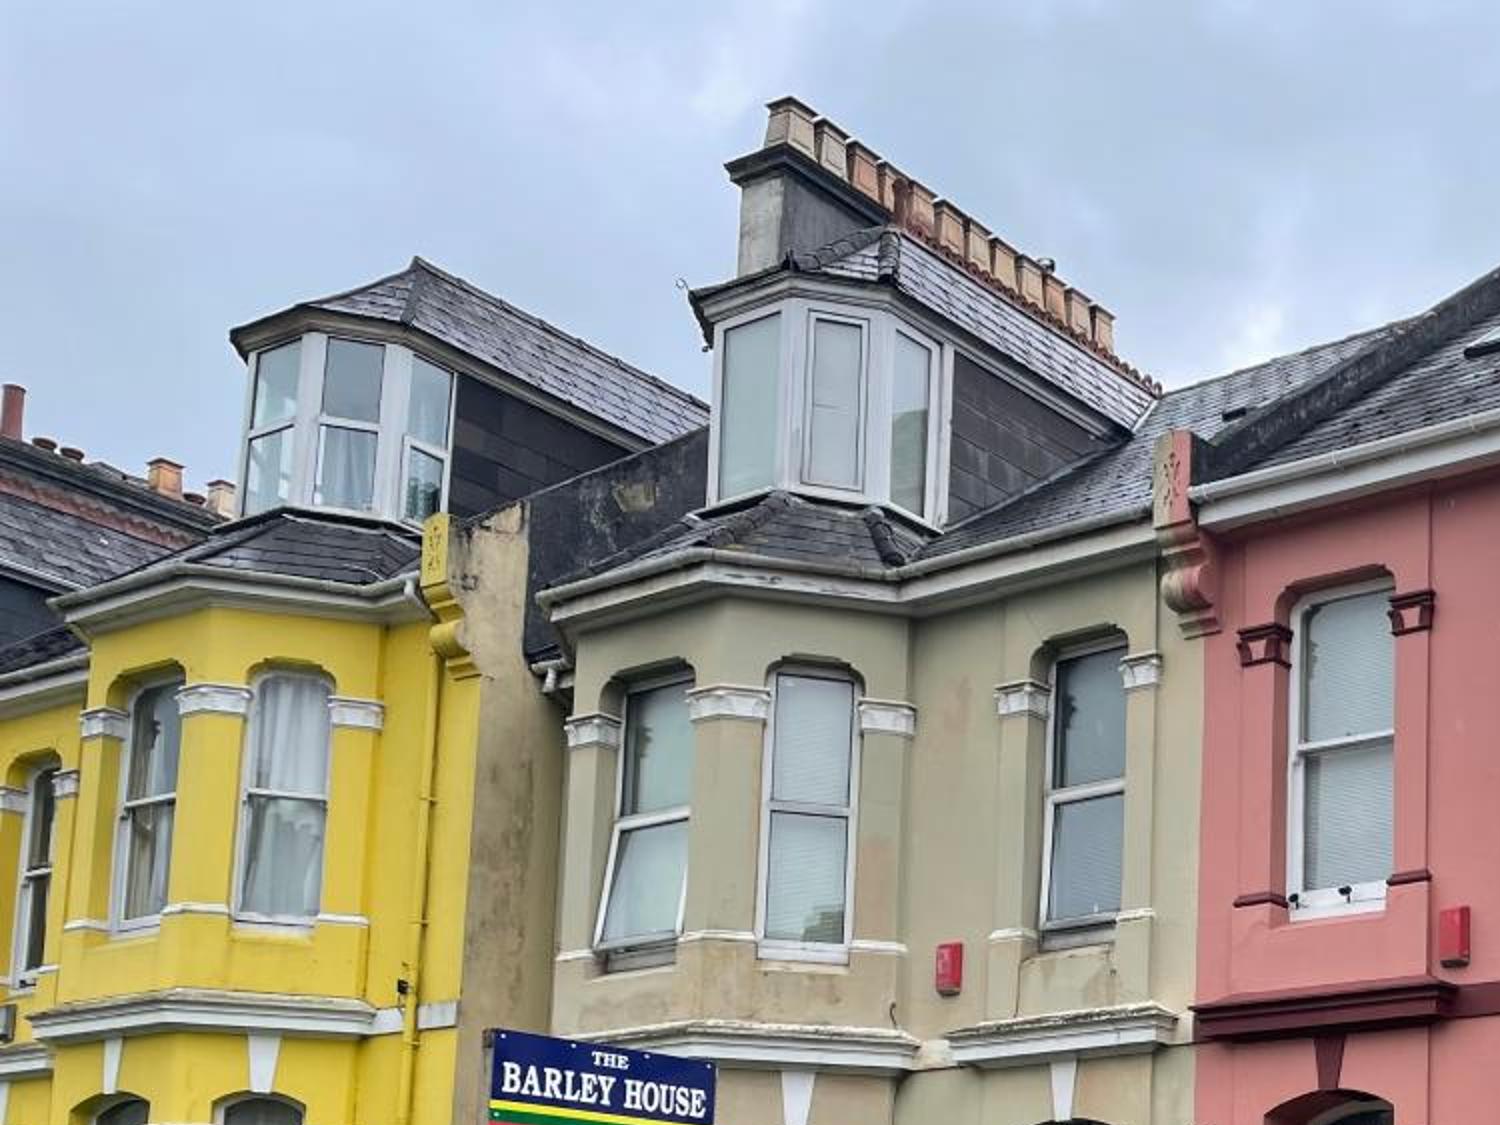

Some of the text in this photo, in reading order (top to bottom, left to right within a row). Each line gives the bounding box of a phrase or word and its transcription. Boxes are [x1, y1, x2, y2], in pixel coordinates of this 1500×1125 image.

[592, 1051, 630, 1070] THE
[502, 1062, 706, 1118] BARLEY HOUSE
